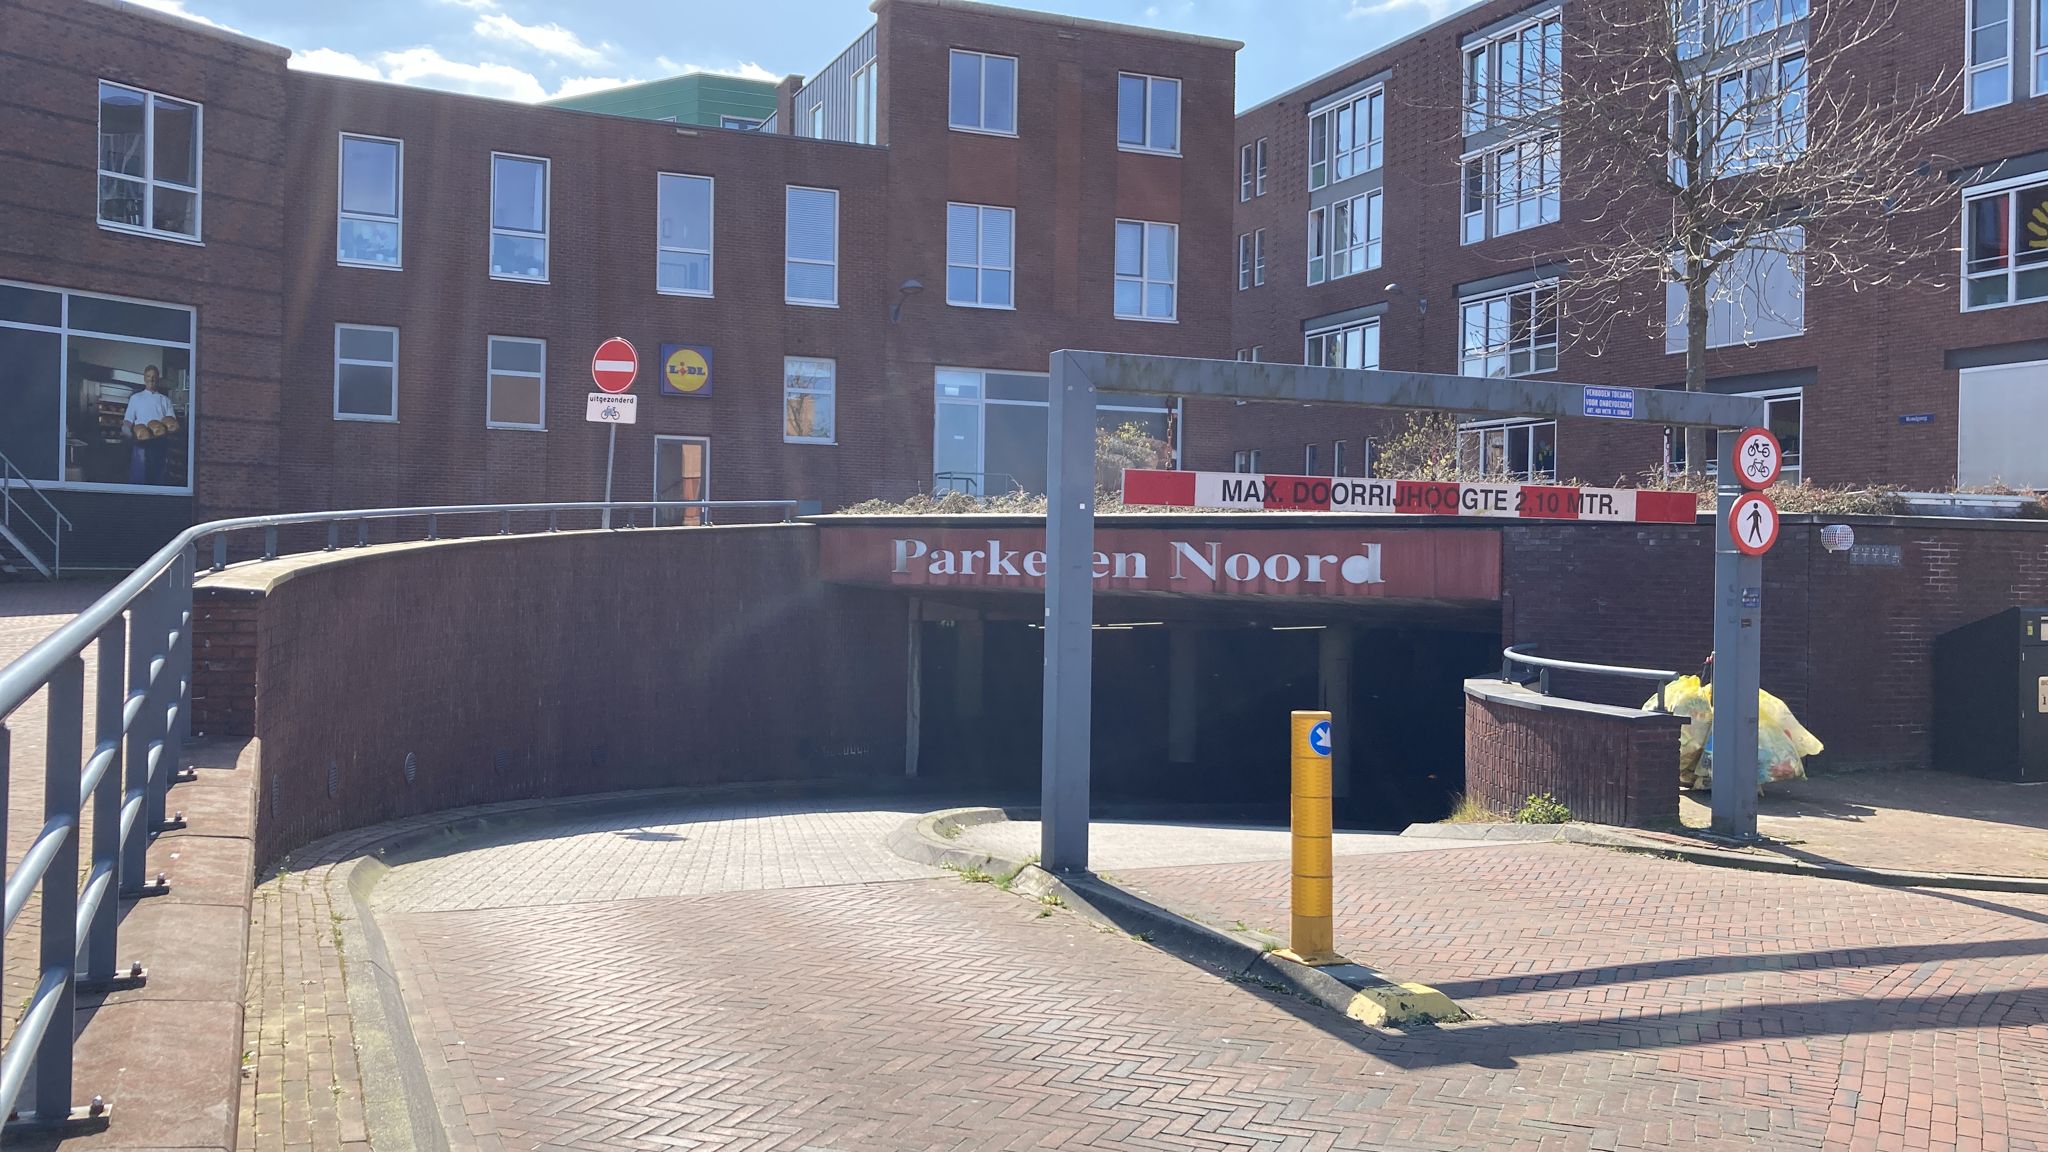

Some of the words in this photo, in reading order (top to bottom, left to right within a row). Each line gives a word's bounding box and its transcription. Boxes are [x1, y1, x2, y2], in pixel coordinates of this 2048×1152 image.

[589, 396, 634, 404] uitgezonderd
[1612, 391, 1632, 399] TOEGANG
[1221, 479, 1283, 503] MAX.
[1292, 481, 1508, 511] DOORRIJHOOGTE
[1514, 491, 1560, 514] 2,10
[1567, 493, 1619, 515] MTR.
[891, 538, 1149, 579] Parkeen
[1169, 541, 1386, 584] Noord
